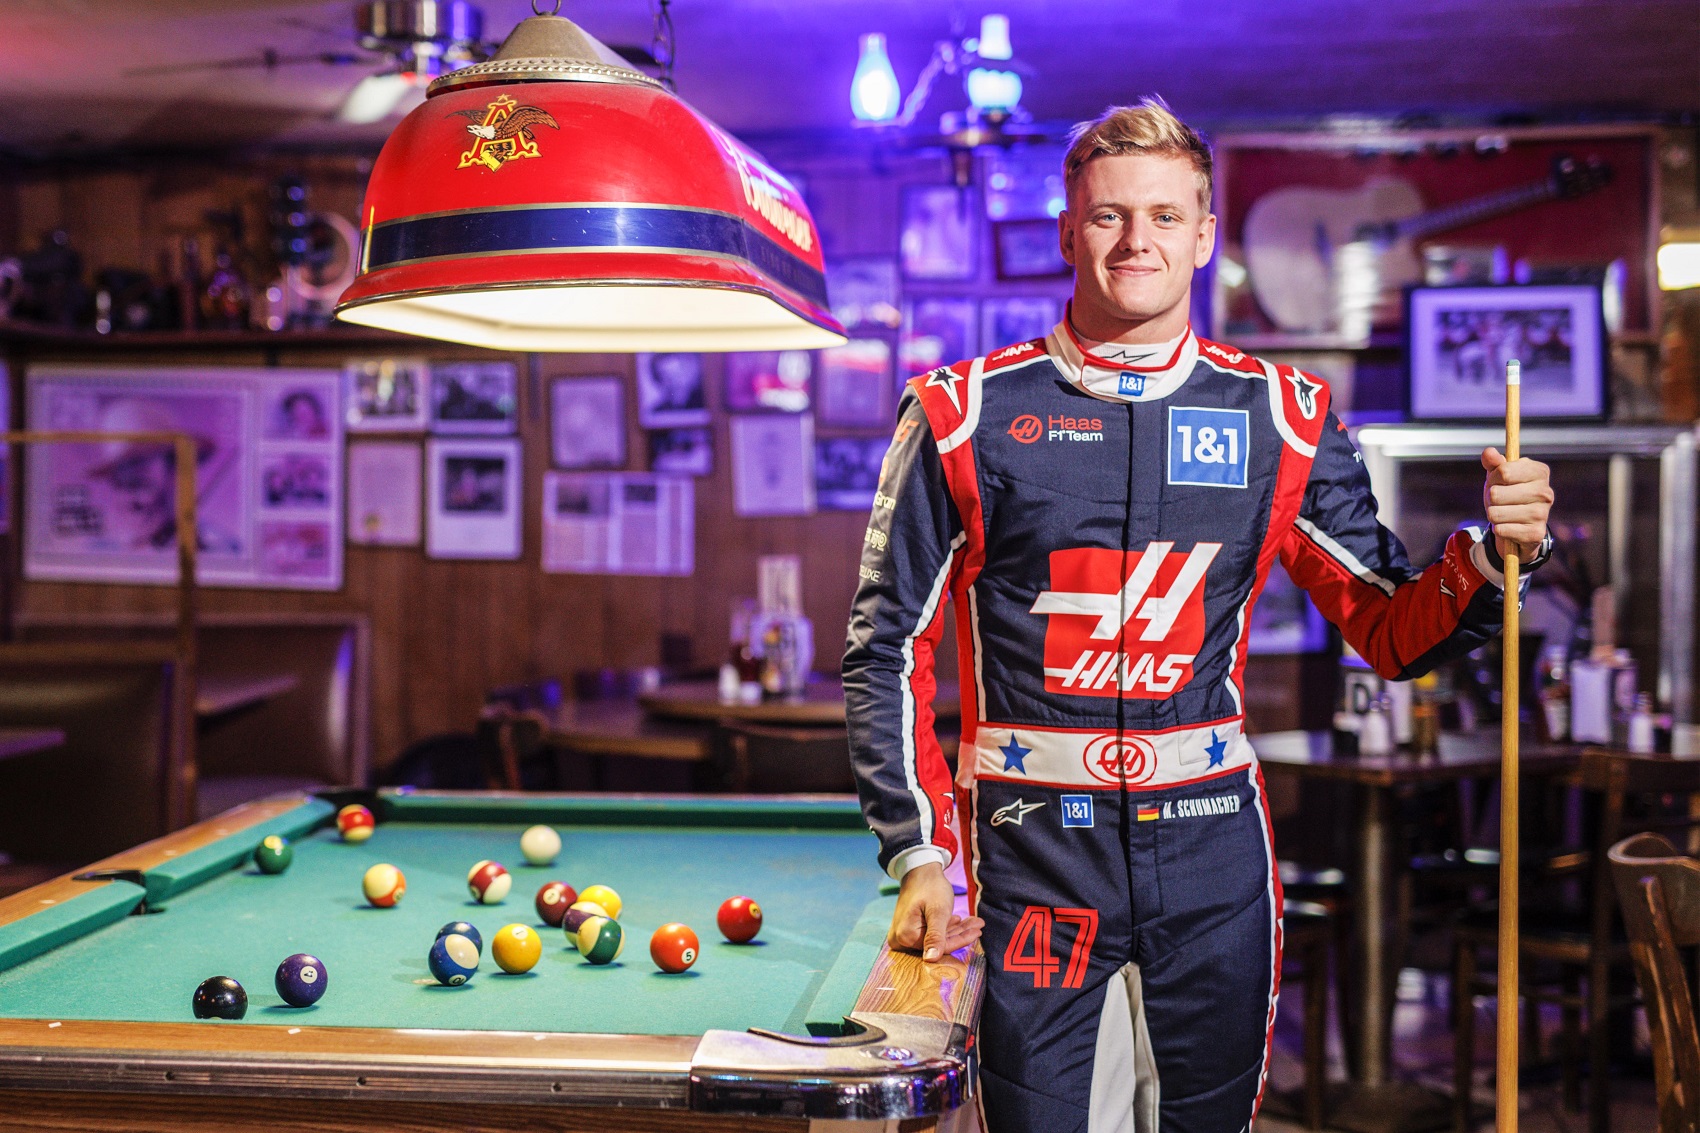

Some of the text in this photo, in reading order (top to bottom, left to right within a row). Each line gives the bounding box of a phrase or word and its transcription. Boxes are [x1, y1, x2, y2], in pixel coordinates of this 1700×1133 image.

[1121, 375, 1142, 391] 1&1
[1048, 414, 1103, 430] Haas
[1065, 430, 1104, 441] Team
[1177, 425, 1238, 465] 1&1
[1044, 649, 1197, 693] HAAS
[1064, 802, 1089, 819] 1&1
[1162, 794, 1240, 819] M. SCHUMACHER
[1003, 905, 1099, 989] 47
[685, 951, 693, 962] 5
